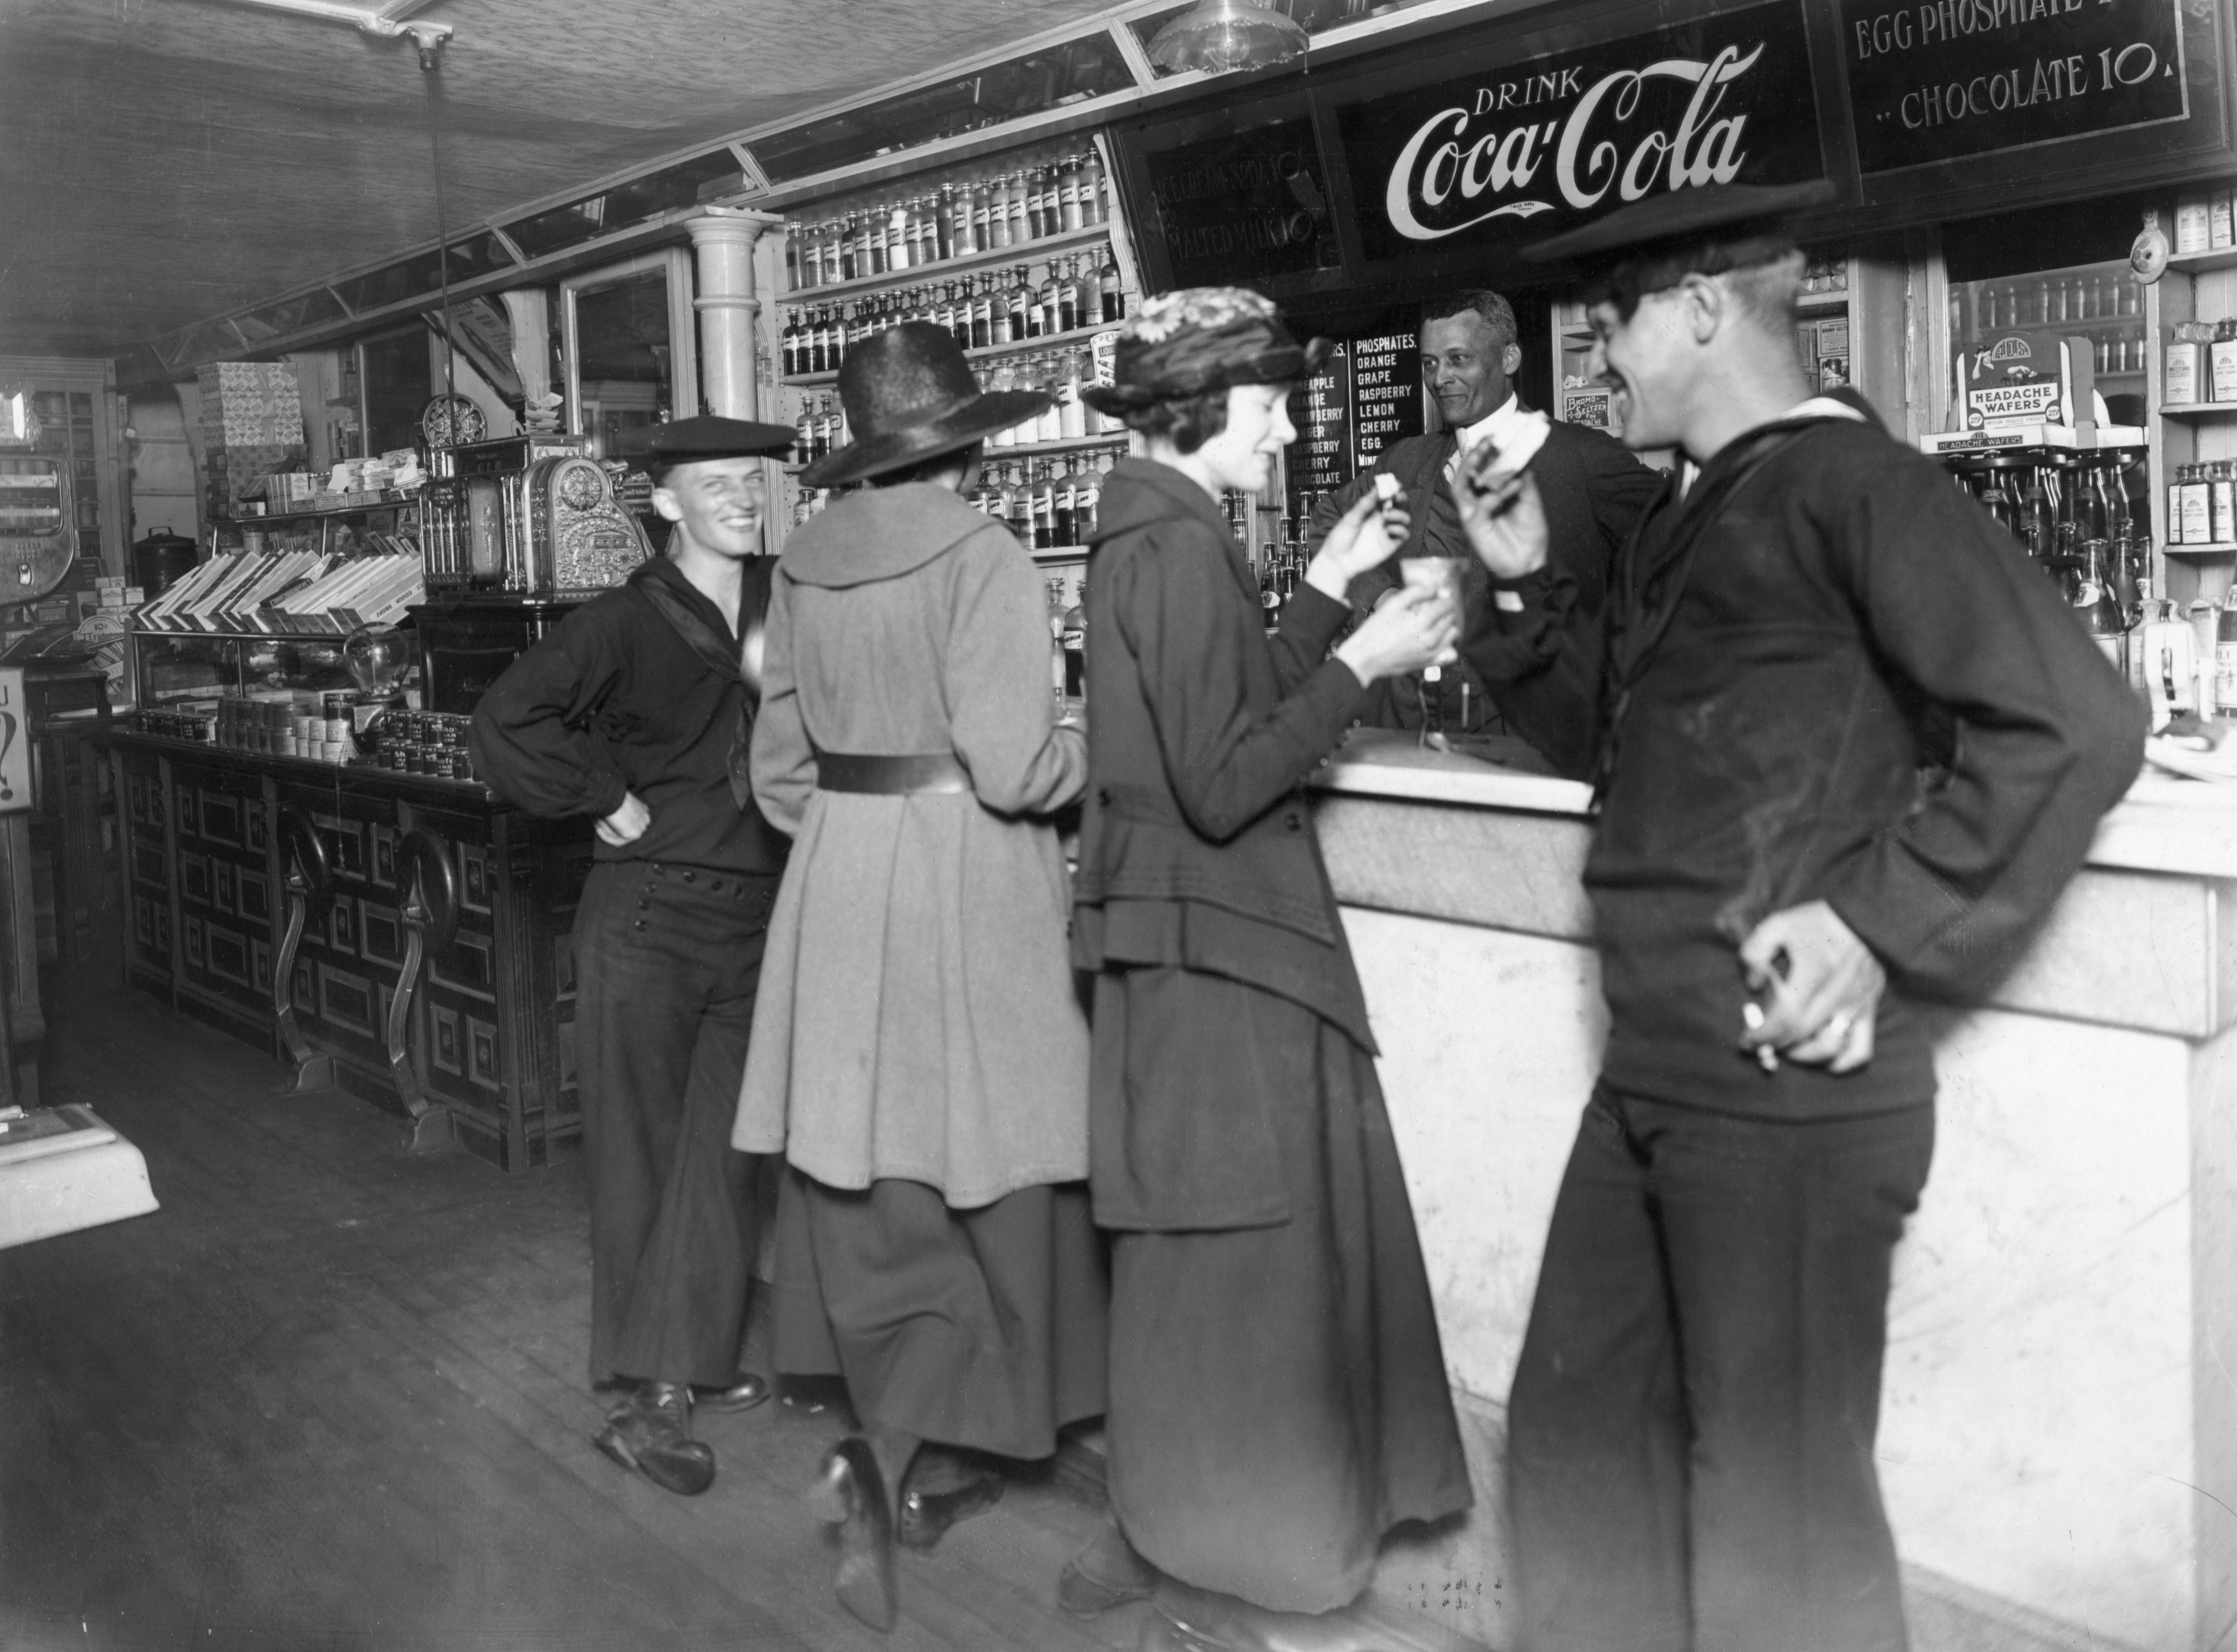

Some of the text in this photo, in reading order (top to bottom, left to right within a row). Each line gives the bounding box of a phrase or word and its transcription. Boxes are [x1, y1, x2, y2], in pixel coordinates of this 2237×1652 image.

[1855, 9, 1913, 60] EGG
[1472, 65, 1584, 116] DRINK
[1901, 55, 2088, 129] CHOCOLATE
[1356, 333, 1418, 354] PHOSPHATES.
[1357, 354, 1397, 370] ORANGE
[1357, 370, 1391, 386] GRAPE
[1359, 385, 1412, 402] RASPBERRY
[1975, 387, 2052, 403] HEADACHE
[1359, 403, 1395, 418] LEMON
[1567, 396, 1599, 412] BROMO-
[1574, 403, 1607, 419] SELTZER
[1984, 399, 2041, 413] WAFERS
[1360, 419, 1401, 434] CHERRY
[1939, 436, 2022, 450] HEADACHE WAFERS
[1293, 471, 1341, 486] CHOCOLATE
[394, 590, 413, 605] COUGH
[376, 603, 393, 619] DROPS
